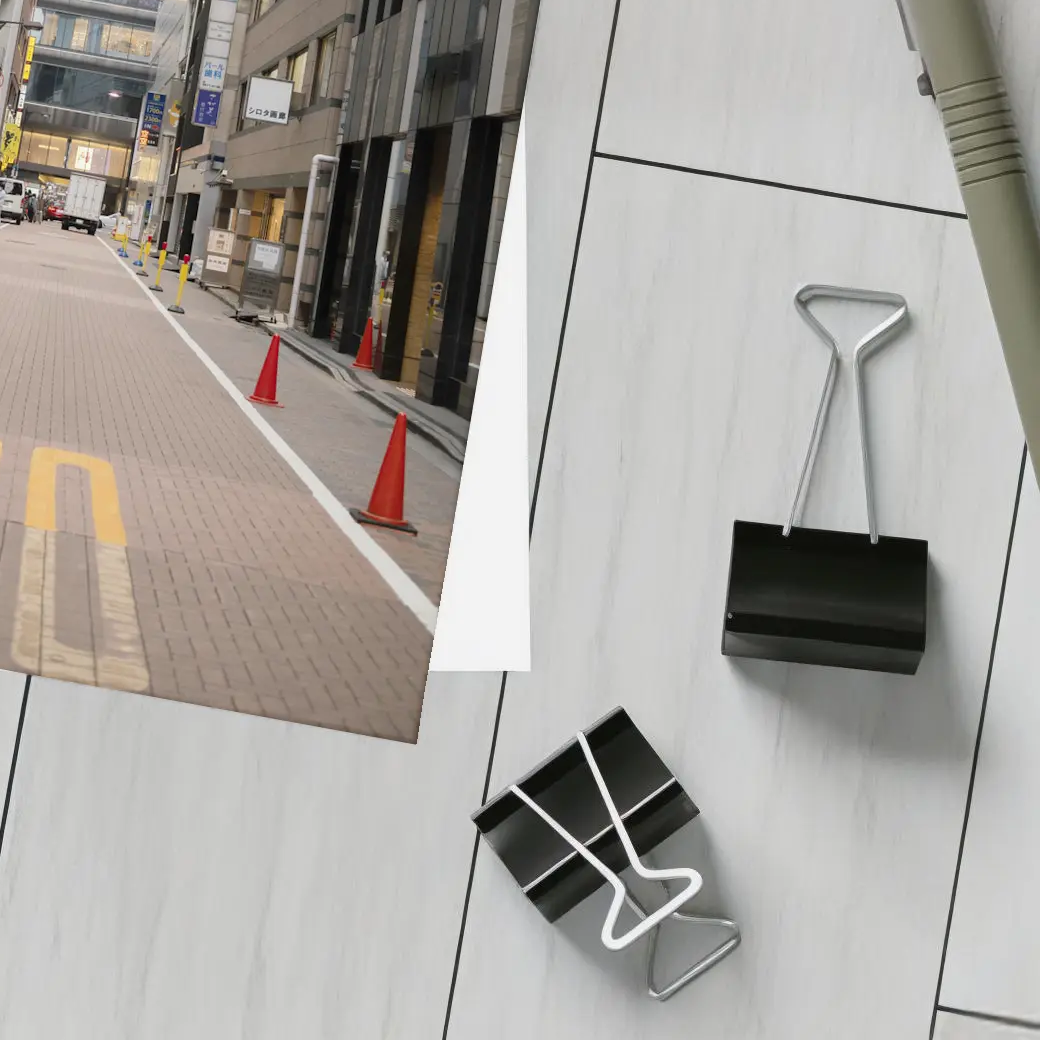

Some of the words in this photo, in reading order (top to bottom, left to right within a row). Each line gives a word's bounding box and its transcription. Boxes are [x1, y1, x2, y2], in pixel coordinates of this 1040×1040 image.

[248, 107, 286, 120] シロタ画廊
